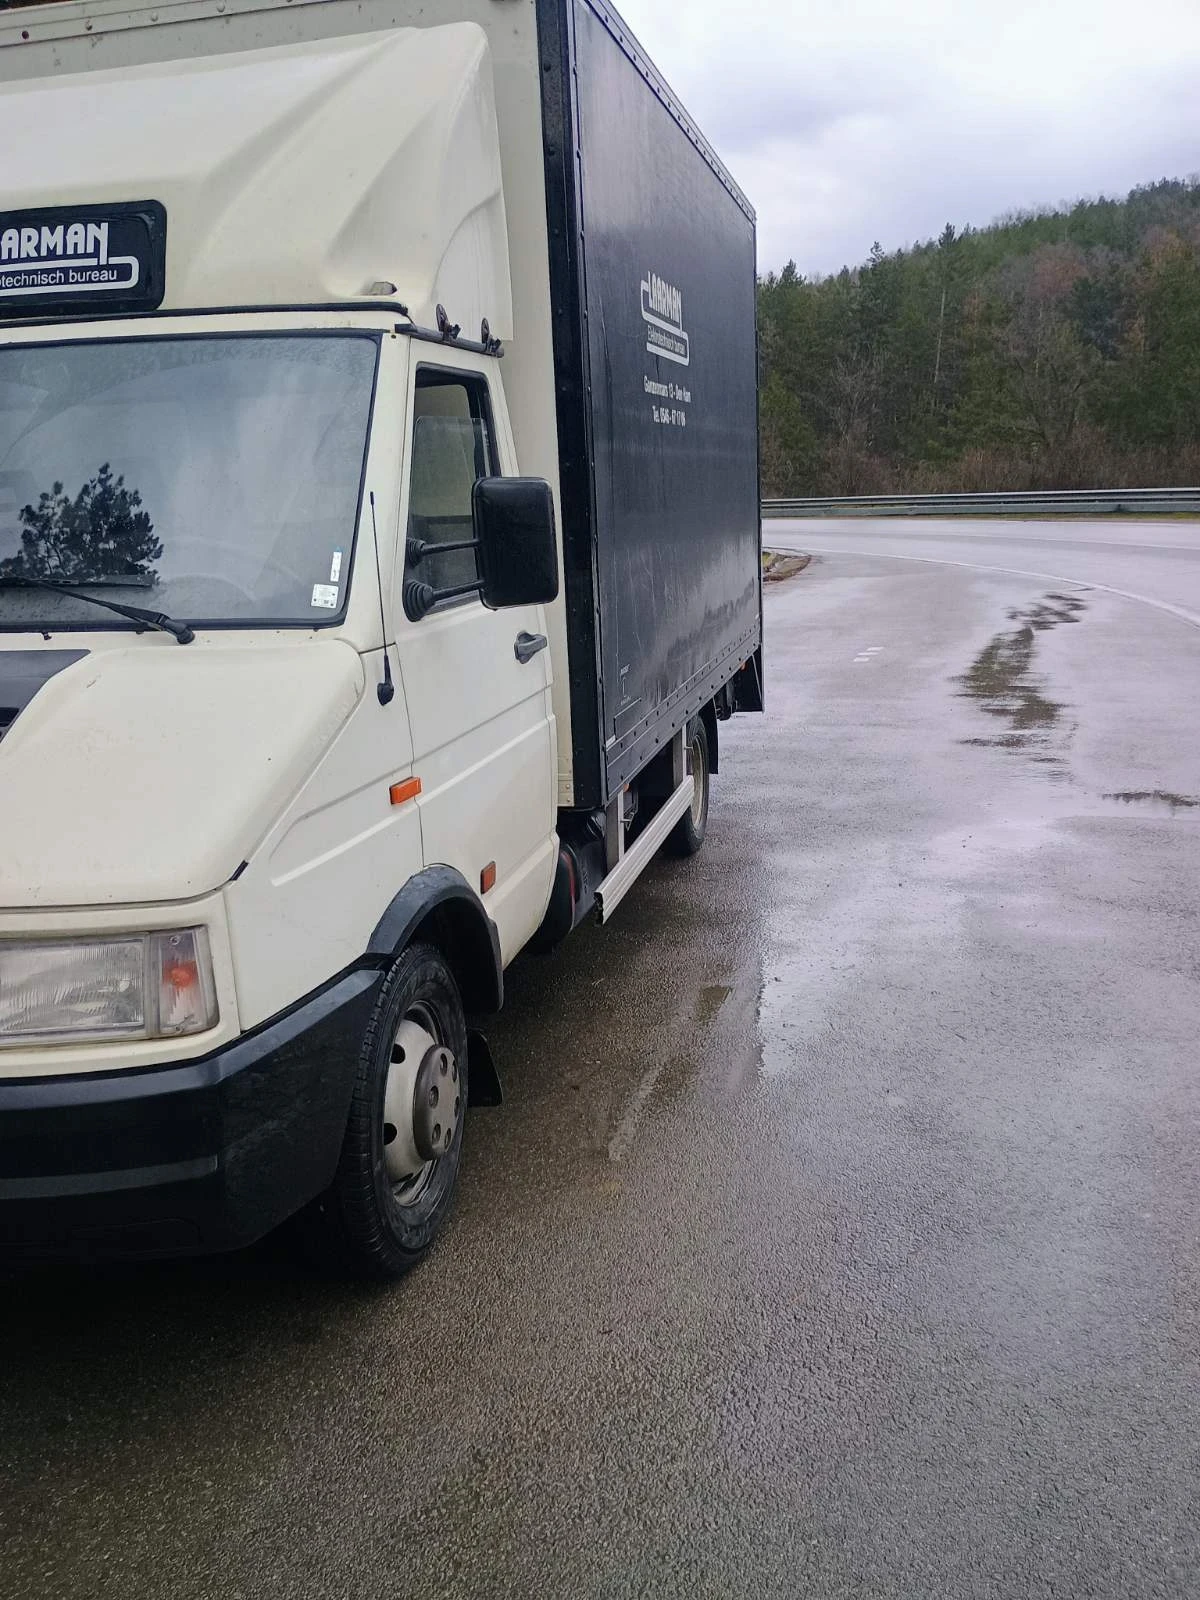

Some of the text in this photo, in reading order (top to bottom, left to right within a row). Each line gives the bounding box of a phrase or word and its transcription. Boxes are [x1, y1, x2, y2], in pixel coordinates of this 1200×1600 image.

[0, 222, 109, 265] ARMAN
[0, 269, 118, 288] technisch bureau
